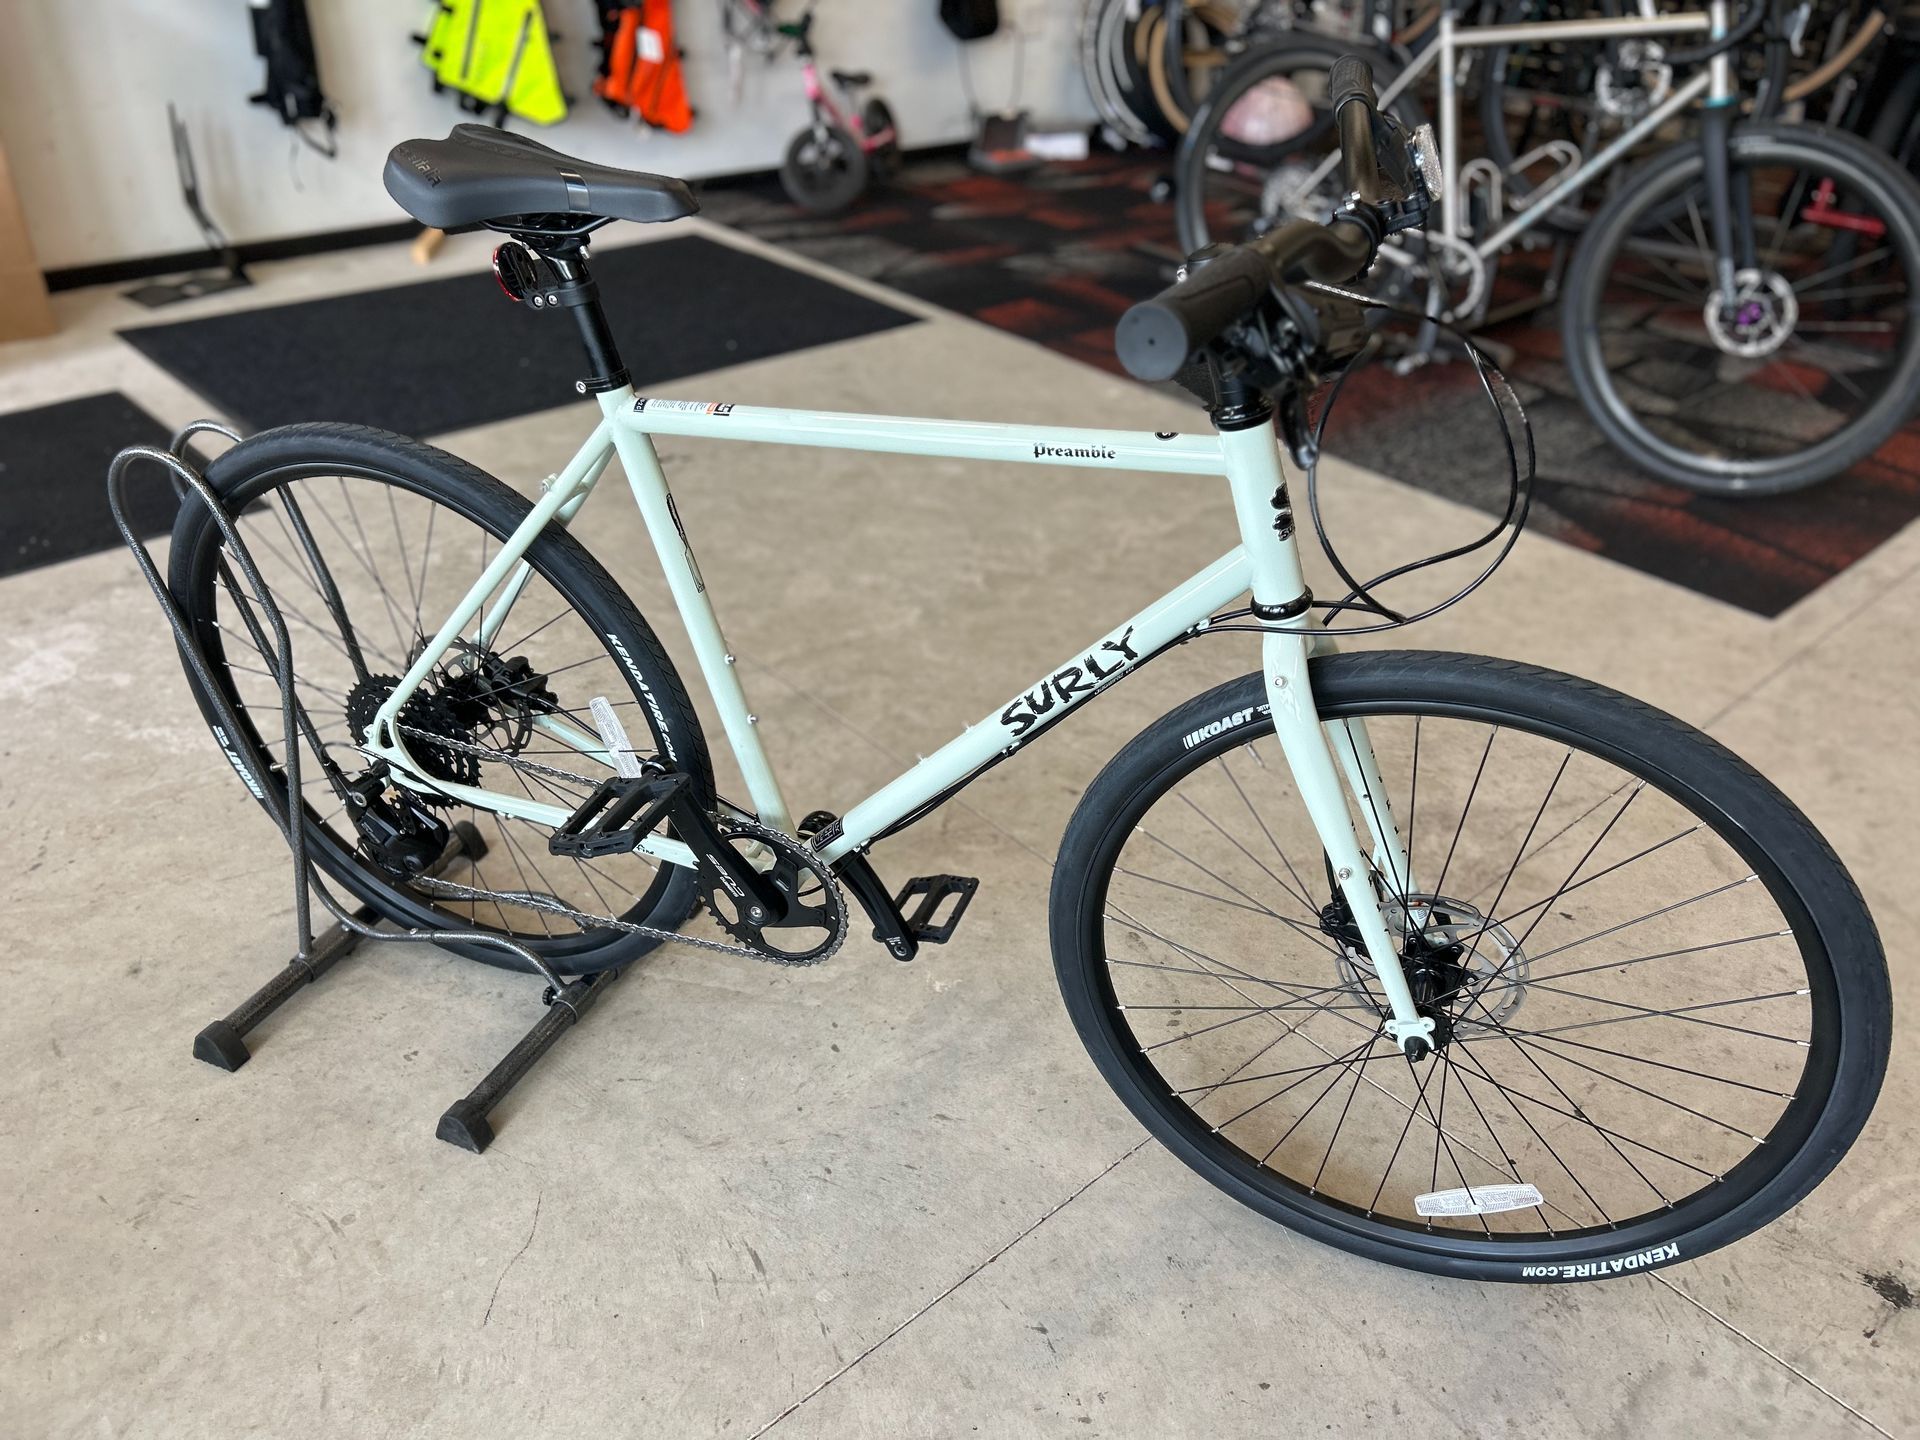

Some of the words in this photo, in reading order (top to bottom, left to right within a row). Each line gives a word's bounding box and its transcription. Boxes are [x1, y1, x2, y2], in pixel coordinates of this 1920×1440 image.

[1033, 442, 1116, 459] Preamble
[606, 633, 678, 762] KENDATIRE.COM
[1001, 625, 1138, 738] SURLY
[1198, 706, 1254, 742] KOAST
[1522, 1242, 1681, 1279] KENDATIRE.COM
